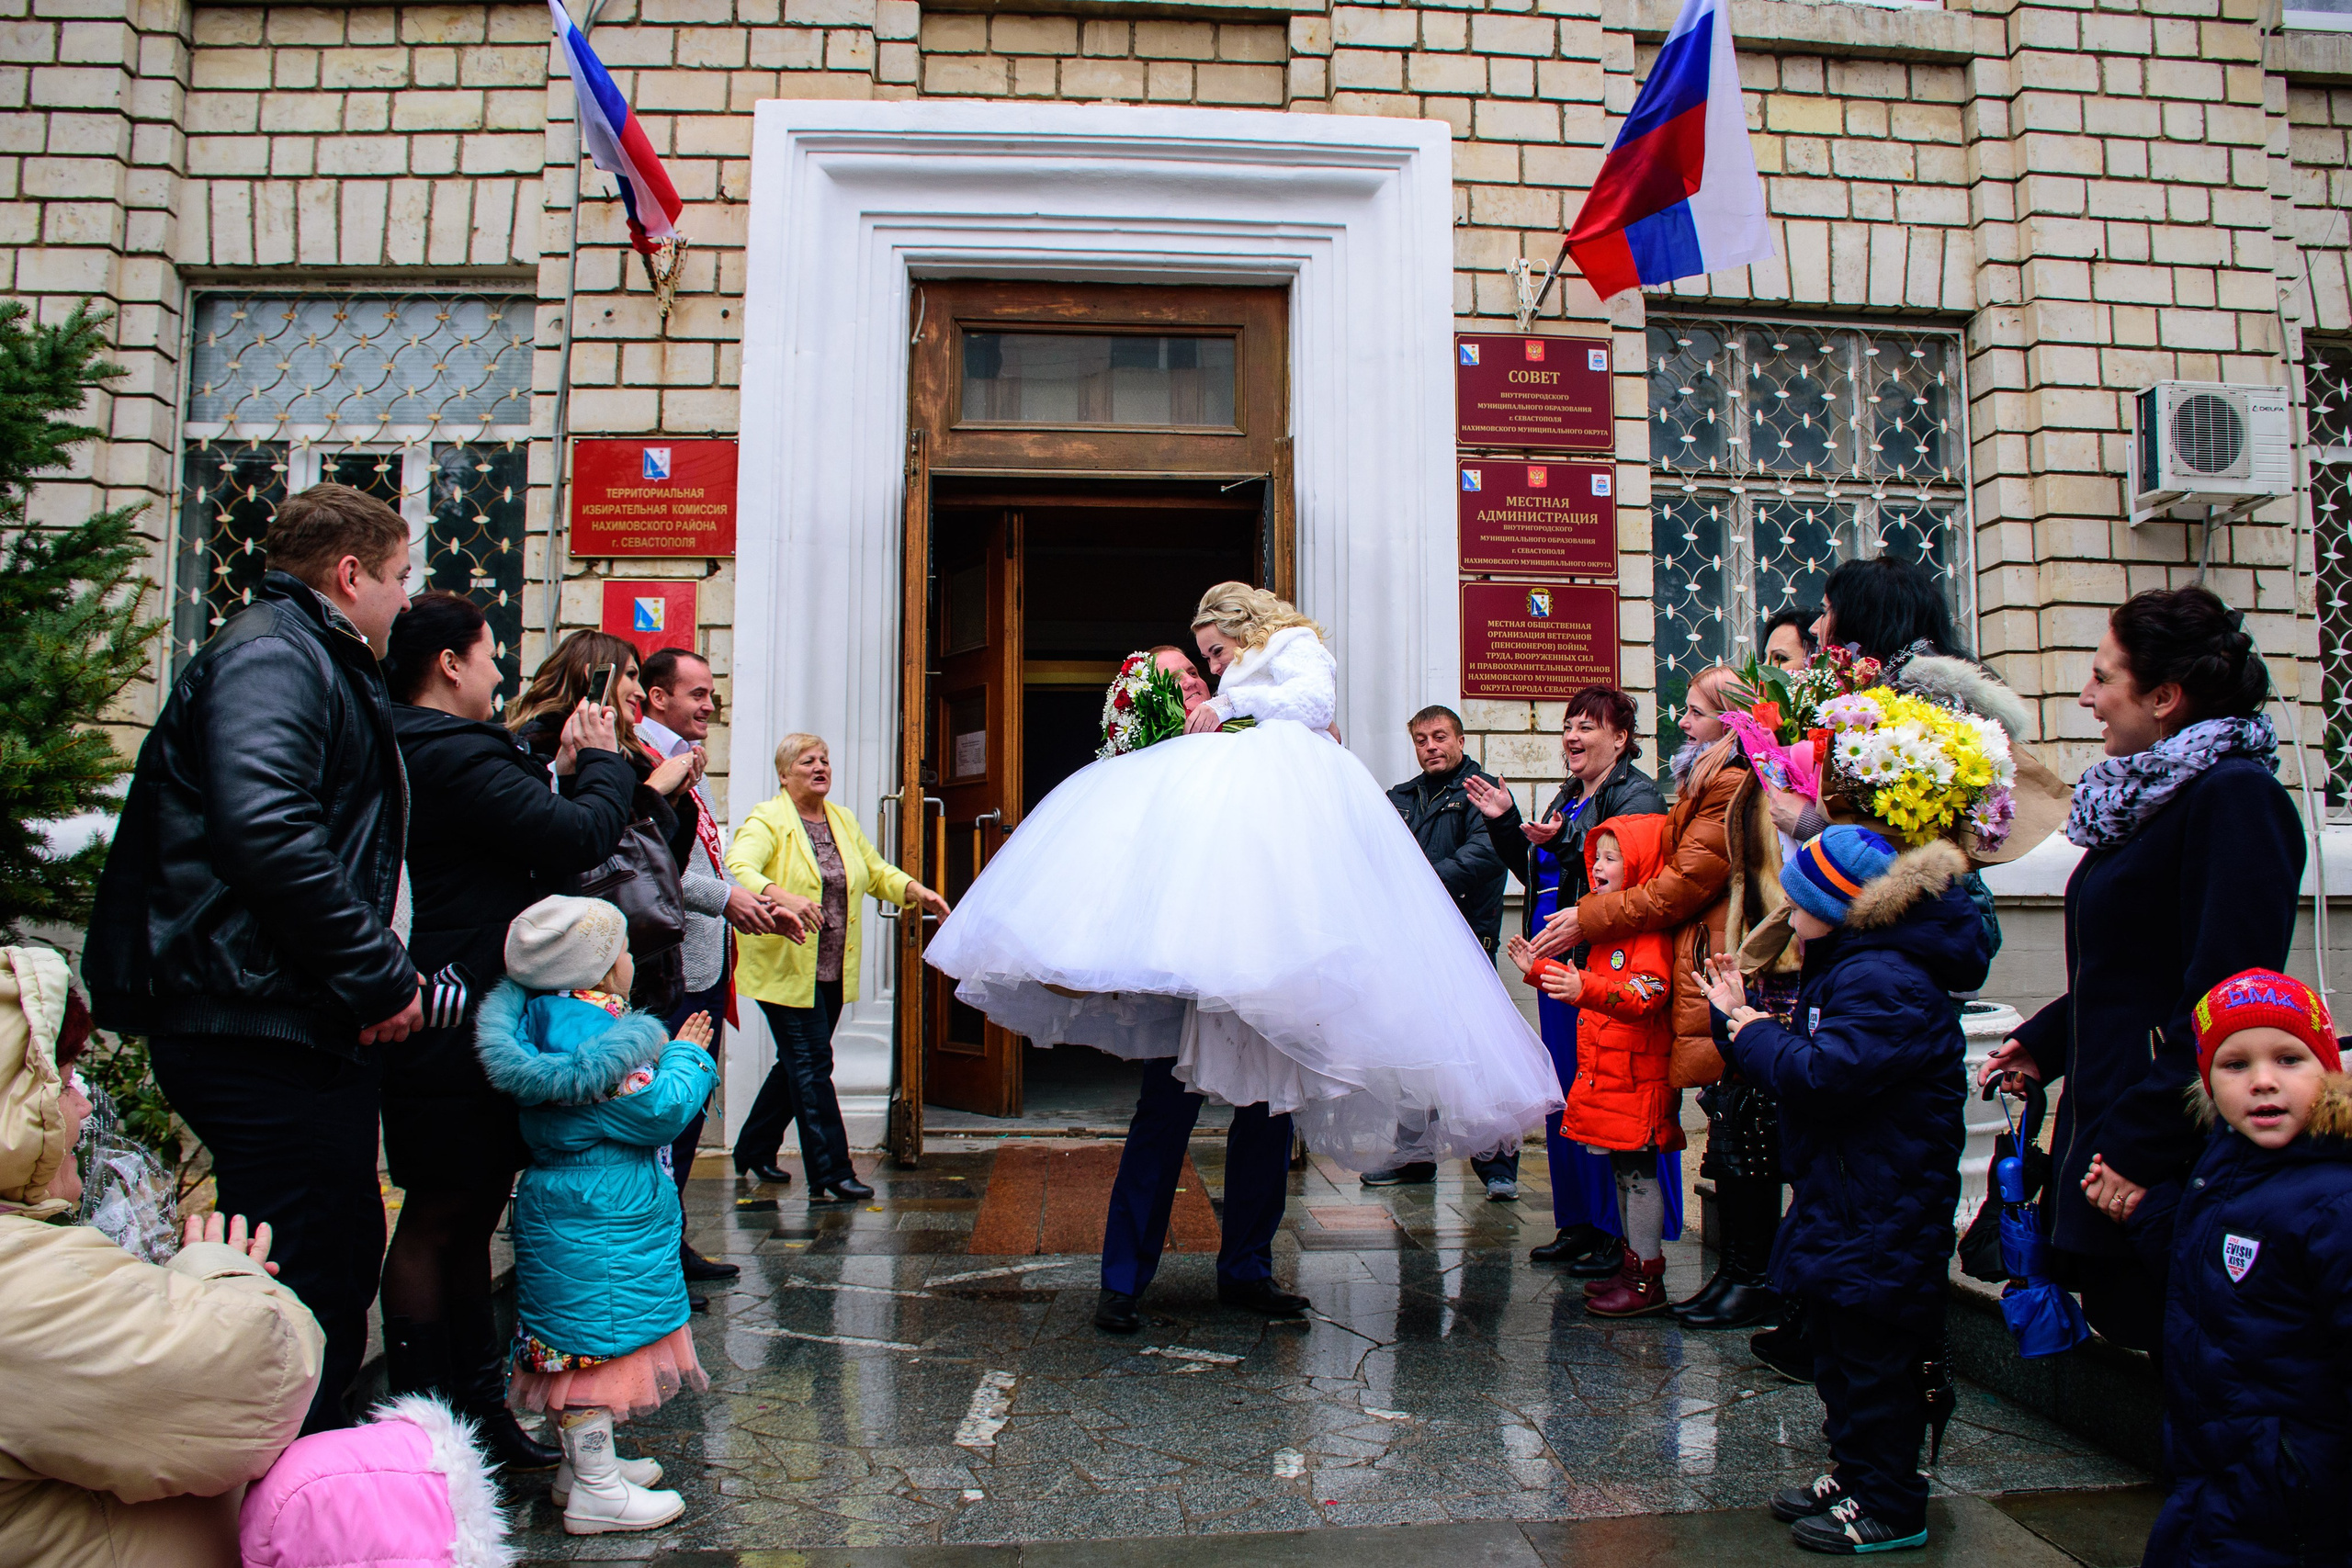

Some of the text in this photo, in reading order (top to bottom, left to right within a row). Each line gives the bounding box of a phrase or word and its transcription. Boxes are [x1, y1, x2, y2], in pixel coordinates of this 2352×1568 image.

[1508, 370, 1560, 385] СОВЕТ
[1500, 392, 1569, 400] ВНУТРИГОРОДСКОГО
[1477, 402, 1592, 413] МУНИЦИПАЛЬНОГО ОБРАЗОВАНИЯ
[1462, 424, 1517, 433] НАХИМОВСКОГО
[1517, 426, 1583, 435] МУНИЦИПАЛЬНОГО
[605, 488, 705, 499] ТЕРРИТОРИАЛЬНАЯ
[1506, 496, 1569, 509] МЕСТНАЯ
[582, 504, 728, 514] ИЗБИРАТЕЛЬНАЯ КОМИССИЯ
[1476, 510, 1599, 525] АДМИНИСТРАЦИЯ
[592, 519, 717, 532] НАХИМОВСКОГО РАЙОНА
[1503, 525, 1573, 533] ВНУТРИГОРОДСКОГО
[612, 536, 695, 547] г. СЕВАСТОПОЛЯ
[1479, 535, 1596, 545] МУНИЦИПАЛЬНОГО ОБРАЗОВАНИЯ
[1520, 558, 1587, 568] МУНИЦИПАЛЬНОГО
[1487, 620, 1592, 630] МЕСТНАЯ ОБЩЕСТВЕННАЯ
[1487, 630, 1592, 641] ОРГАНИЗАЦИЯ ВЕТЕРАНОВ
[1490, 641, 1589, 652] (ПЕНСИОНЕРОВ) ВОЙНЫ,
[1486, 652, 1594, 662] ТРУДА, ВООРУЖЕННЫХ СИЛ
[1476, 662, 1574, 672] ПРАВООХРАНИТЕЛЬНЫХ
[1574, 665, 1611, 673] ОРГАНОВ
[1468, 673, 1611, 684] НАХИМОВСКОГО МУНИЦИПАЛЬНОГО
[1480, 684, 1510, 693] ОКРУГА
[1511, 685, 1543, 694] ГОРОДА
[2228, 1255, 2245, 1268] KISS
